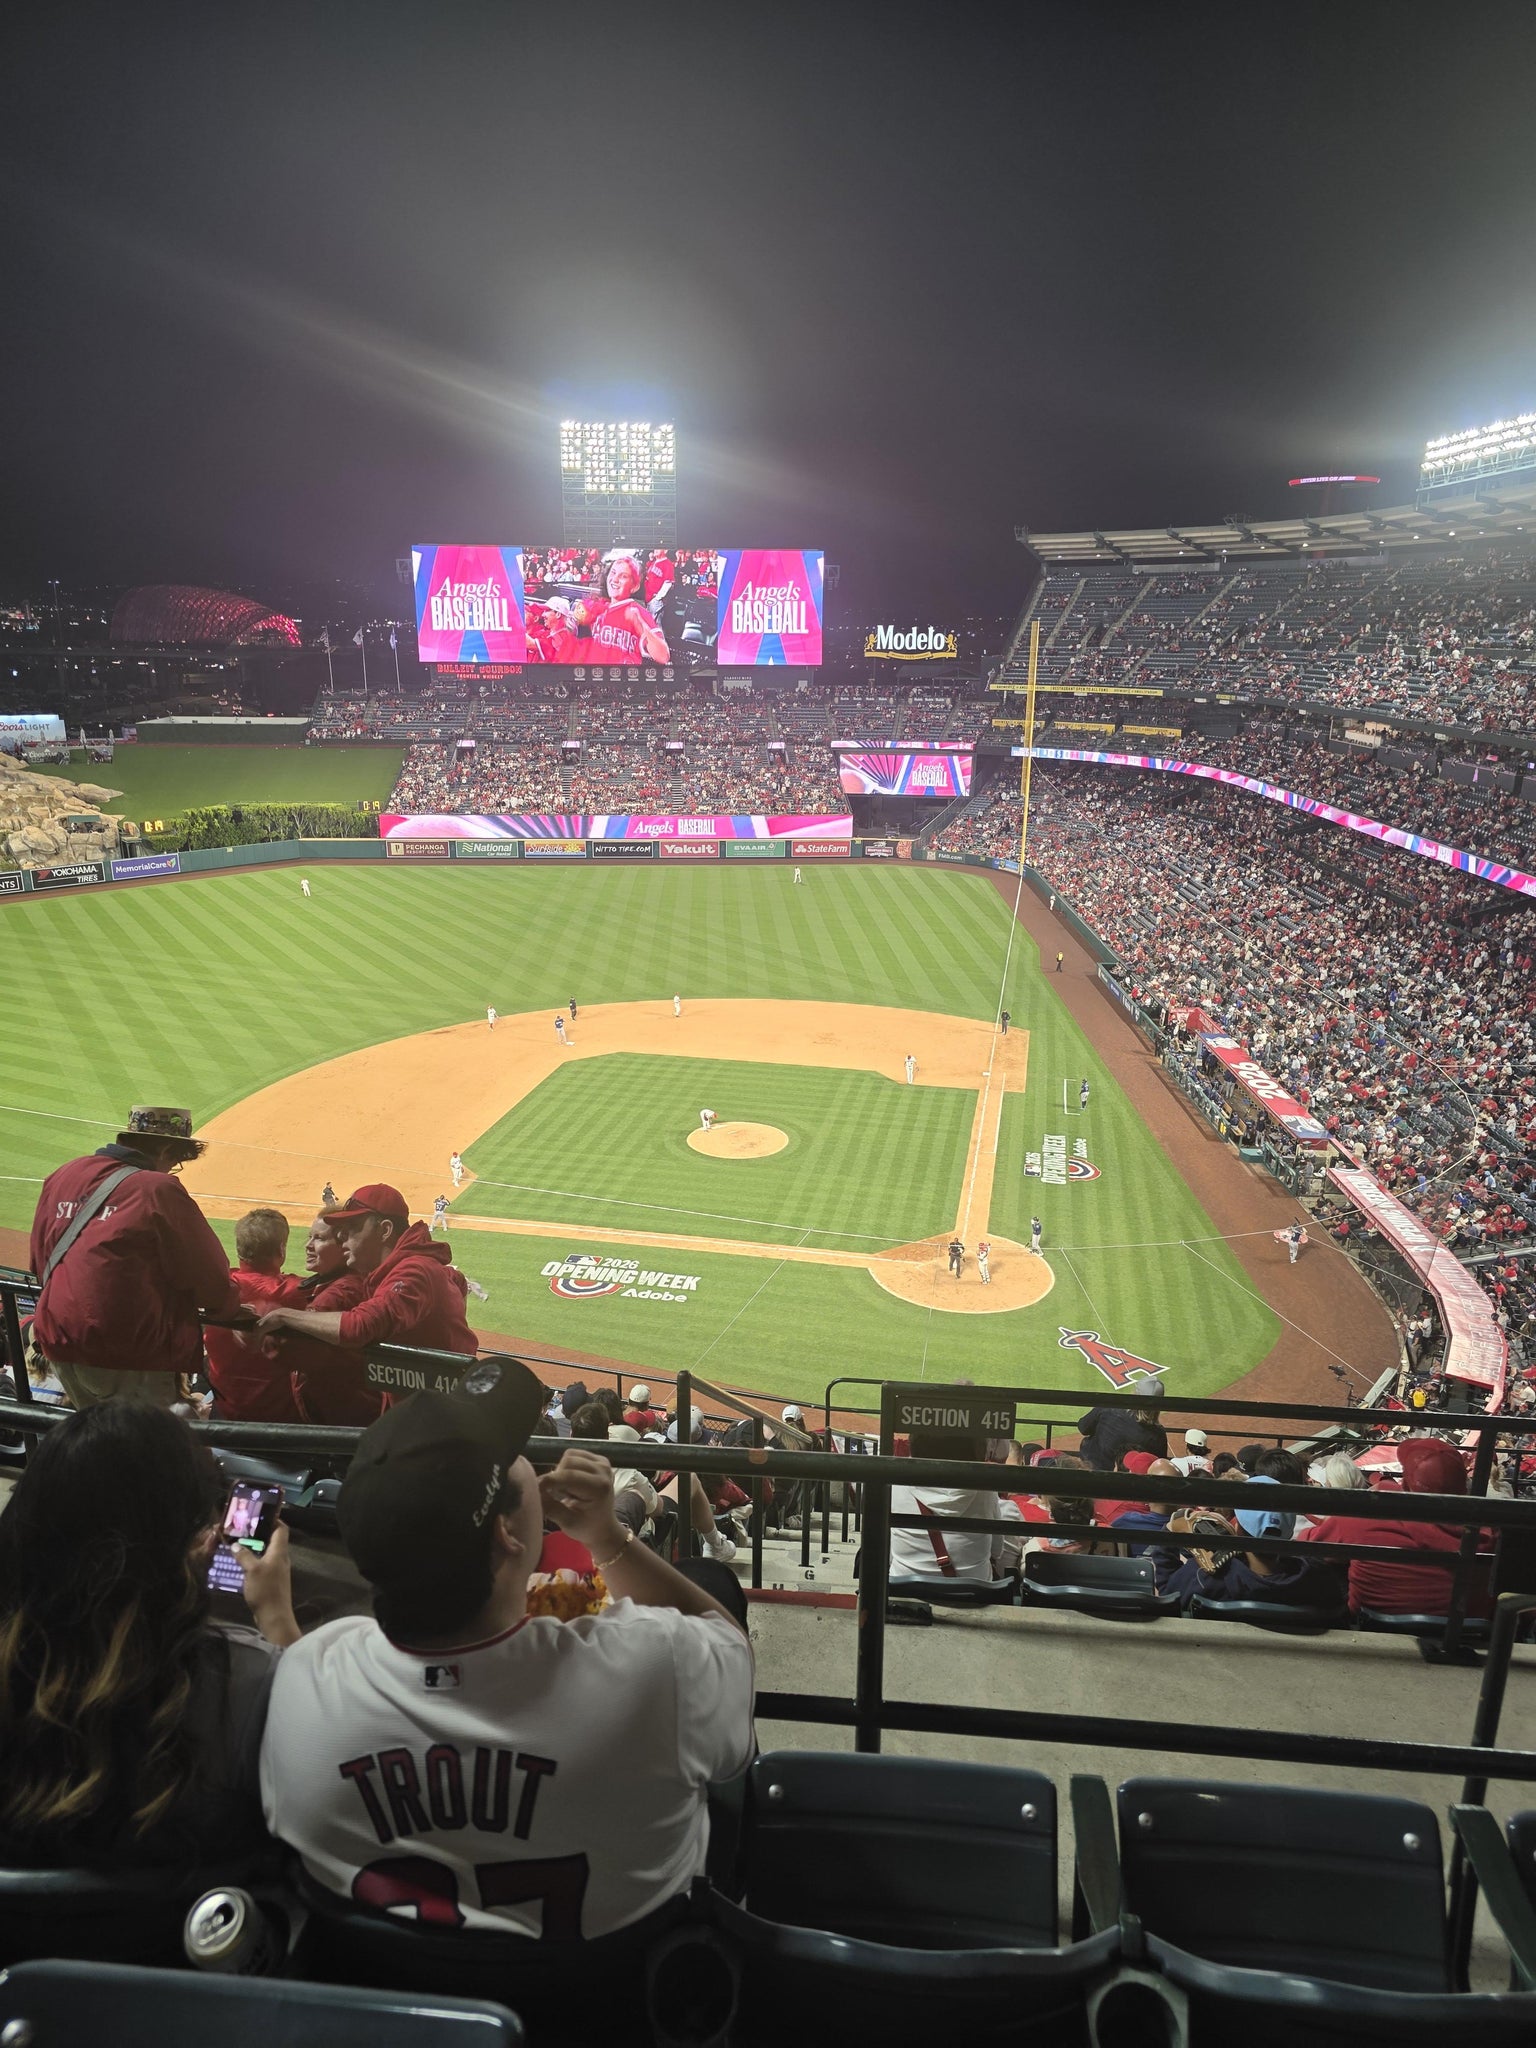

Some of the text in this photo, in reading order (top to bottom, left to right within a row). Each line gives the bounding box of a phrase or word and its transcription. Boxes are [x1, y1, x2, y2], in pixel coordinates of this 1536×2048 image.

[437, 576, 501, 603] Angels
[737, 580, 801, 606] Angels
[430, 597, 512, 631] BASEBALL
[732, 600, 809, 634] BASEBALL
[876, 624, 945, 650] Modelo
[24, 723, 50, 731] LIGHT
[912, 770, 948, 787] BASEBALL
[633, 817, 716, 836] Angels BASEBALL
[473, 842, 513, 853] National
[528, 843, 563, 854] Surfside
[664, 844, 716, 854] Yakult
[51, 865, 98, 877] YOKOHAMA
[115, 861, 167, 873] MemorialCare
[77, 875, 98, 883] TIRES
[1231, 1061, 1291, 1099] 2026
[1042, 1134, 1066, 1153] WEEK
[56, 1201, 117, 1221] STF
[601, 1257, 640, 1270] 2026
[540, 1261, 701, 1291] OPENING WEEK
[621, 1288, 688, 1303] Adobe
[368, 1363, 426, 1390] SECTION
[901, 1405, 1010, 1430] SECTION 415
[473, 1464, 500, 1528] Evelyn
[804, 1570, 815, 1580] G
[339, 1744, 558, 1845] TROUT
